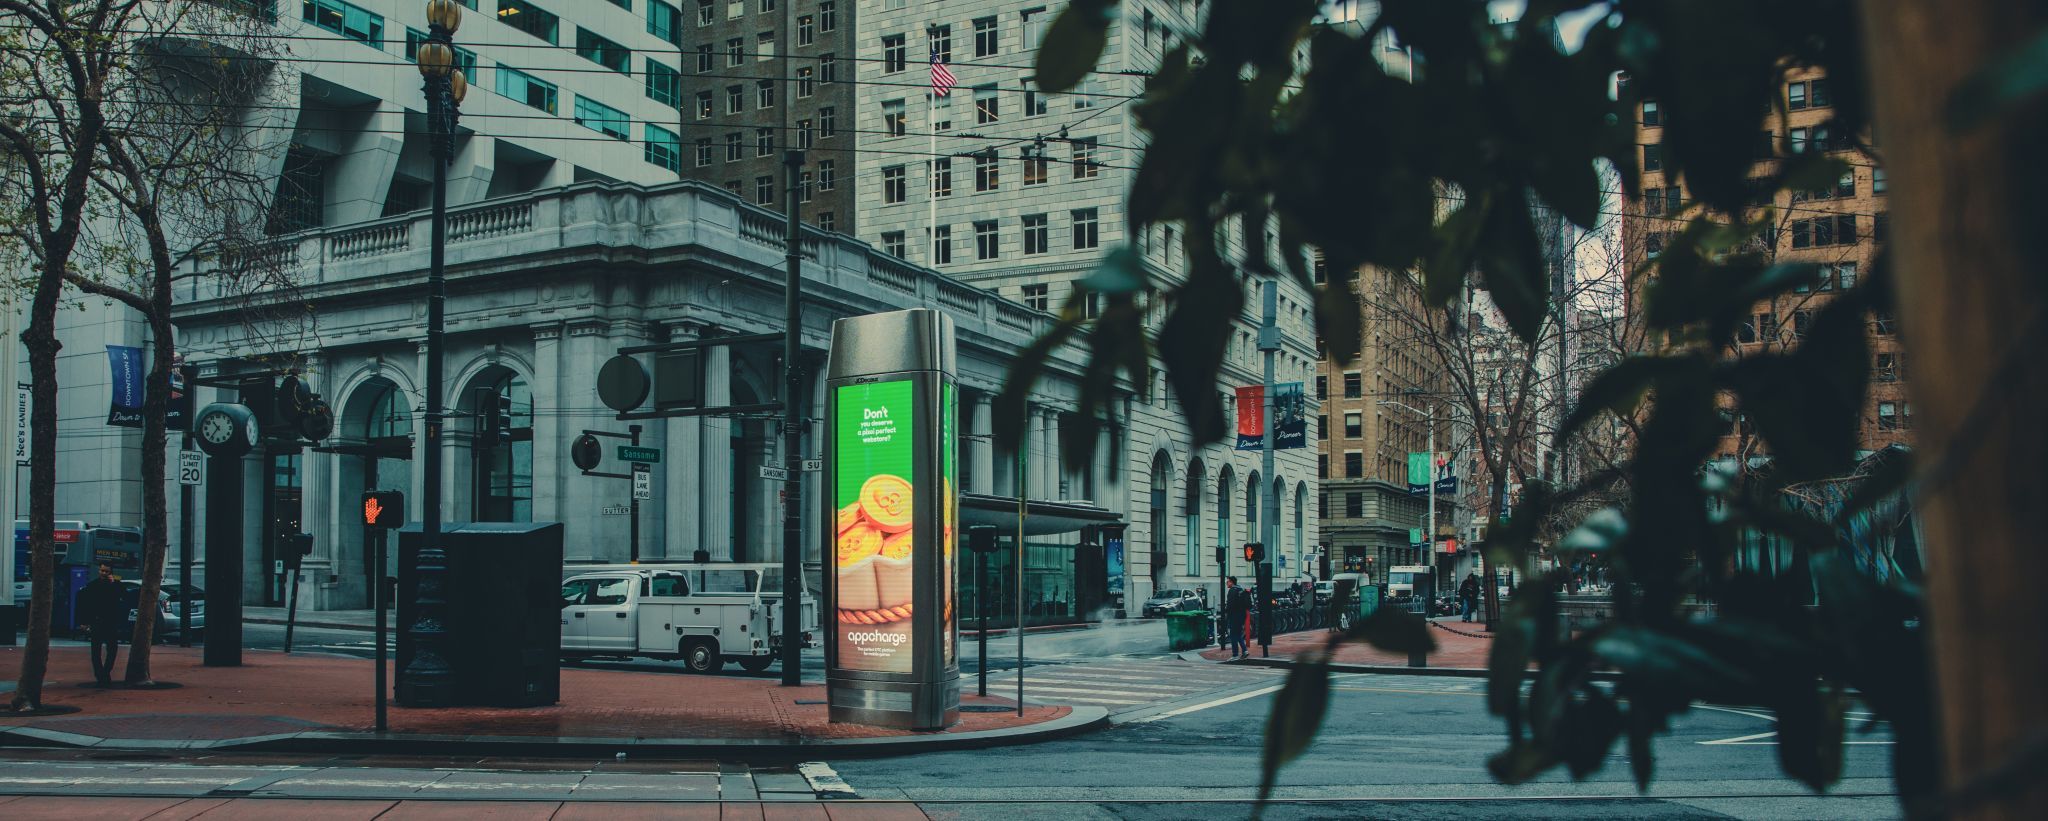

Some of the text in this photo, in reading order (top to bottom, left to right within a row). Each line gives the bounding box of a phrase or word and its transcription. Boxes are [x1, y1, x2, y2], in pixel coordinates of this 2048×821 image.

[864, 406, 888, 419] Don't
[876, 427, 896, 435] perfect
[16, 431, 24, 456] See's
[624, 449, 655, 459] Sansome
[182, 468, 199, 481] 20
[764, 468, 785, 478] SANSOME
[848, 629, 907, 646] appcharge
